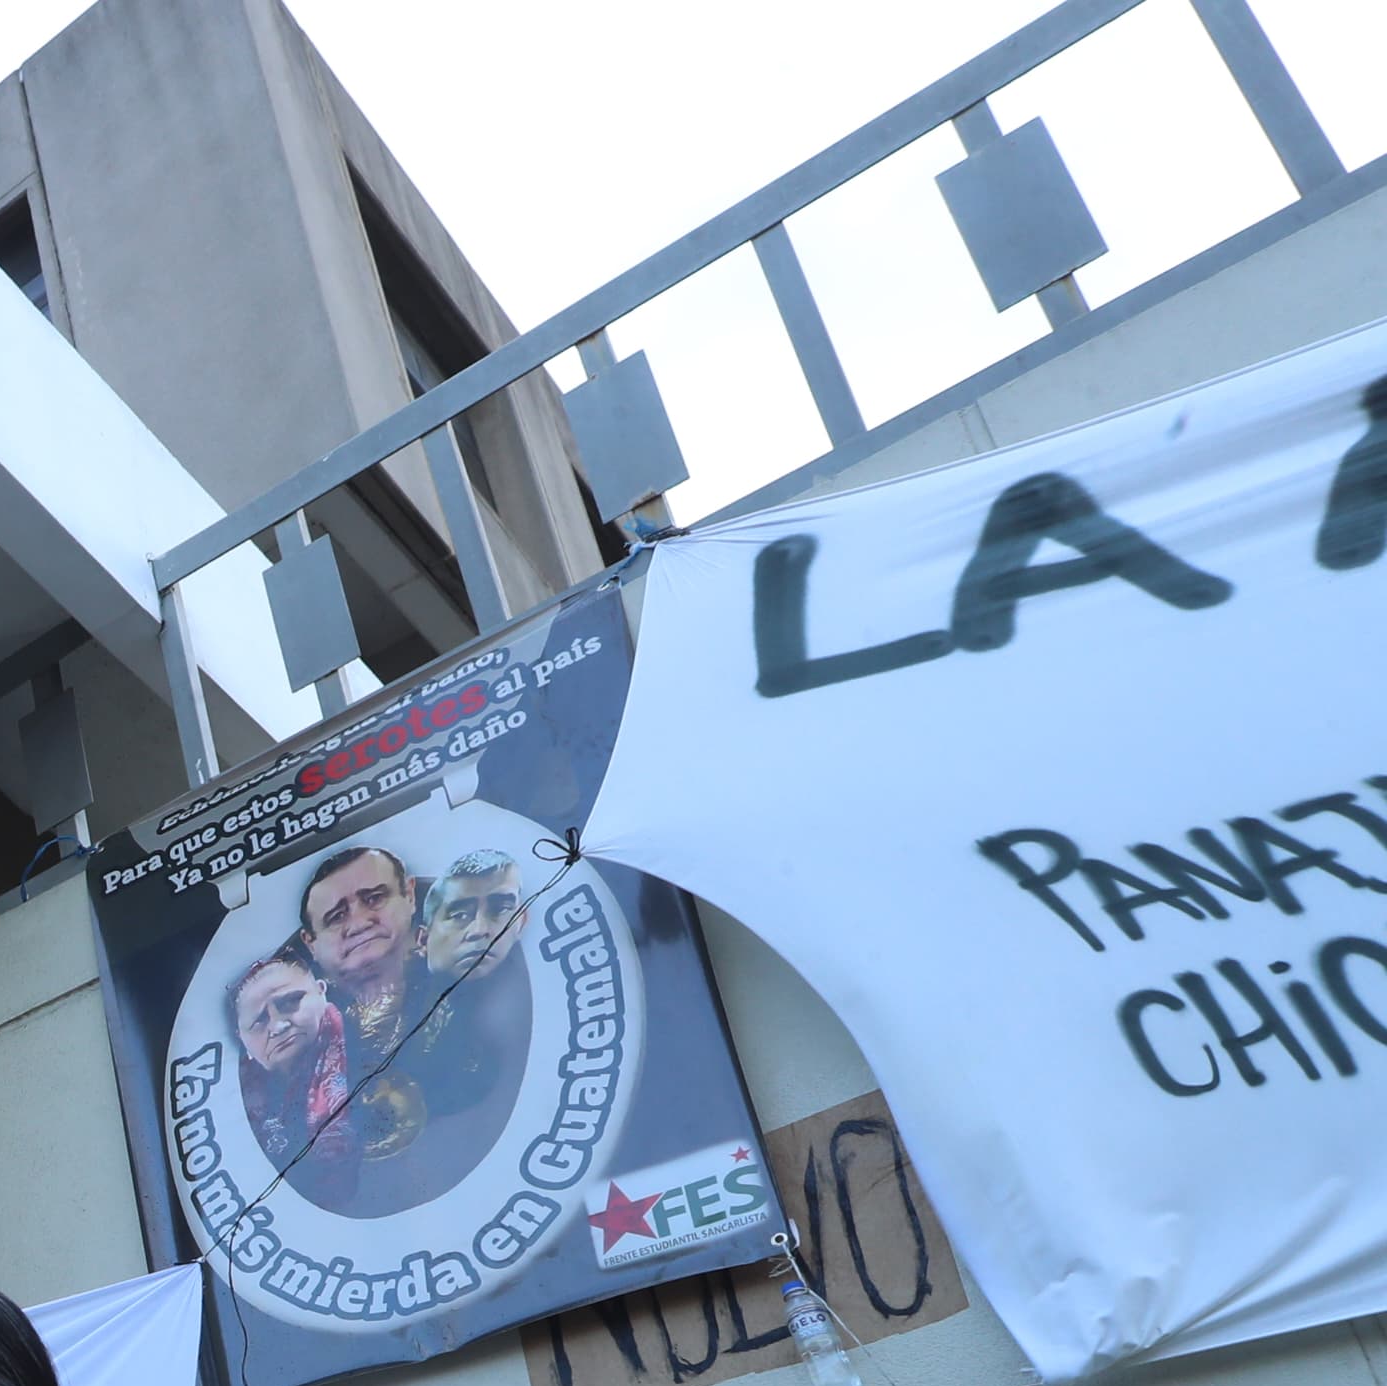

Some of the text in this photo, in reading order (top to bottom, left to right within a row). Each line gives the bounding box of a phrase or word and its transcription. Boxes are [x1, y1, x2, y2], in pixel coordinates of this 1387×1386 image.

[753, 471, 1236, 698] LA
[102, 853, 163, 894] Para
[169, 829, 217, 866] que
[223, 788, 294, 835] estos
[297, 681, 487, 796] serotes
[492, 667, 527, 701] al
[532, 635, 603, 688] país
[168, 711, 528, 895] Ya no le hagan más daño
[173, 885, 624, 1319] Ya no más mierda en Guatemala
[603, 1211, 768, 1267] FRENTE ESTUDIANTIL SANCARLISTA
[651, 1163, 769, 1239] FES
[790, 1313, 827, 1333] CIELO
